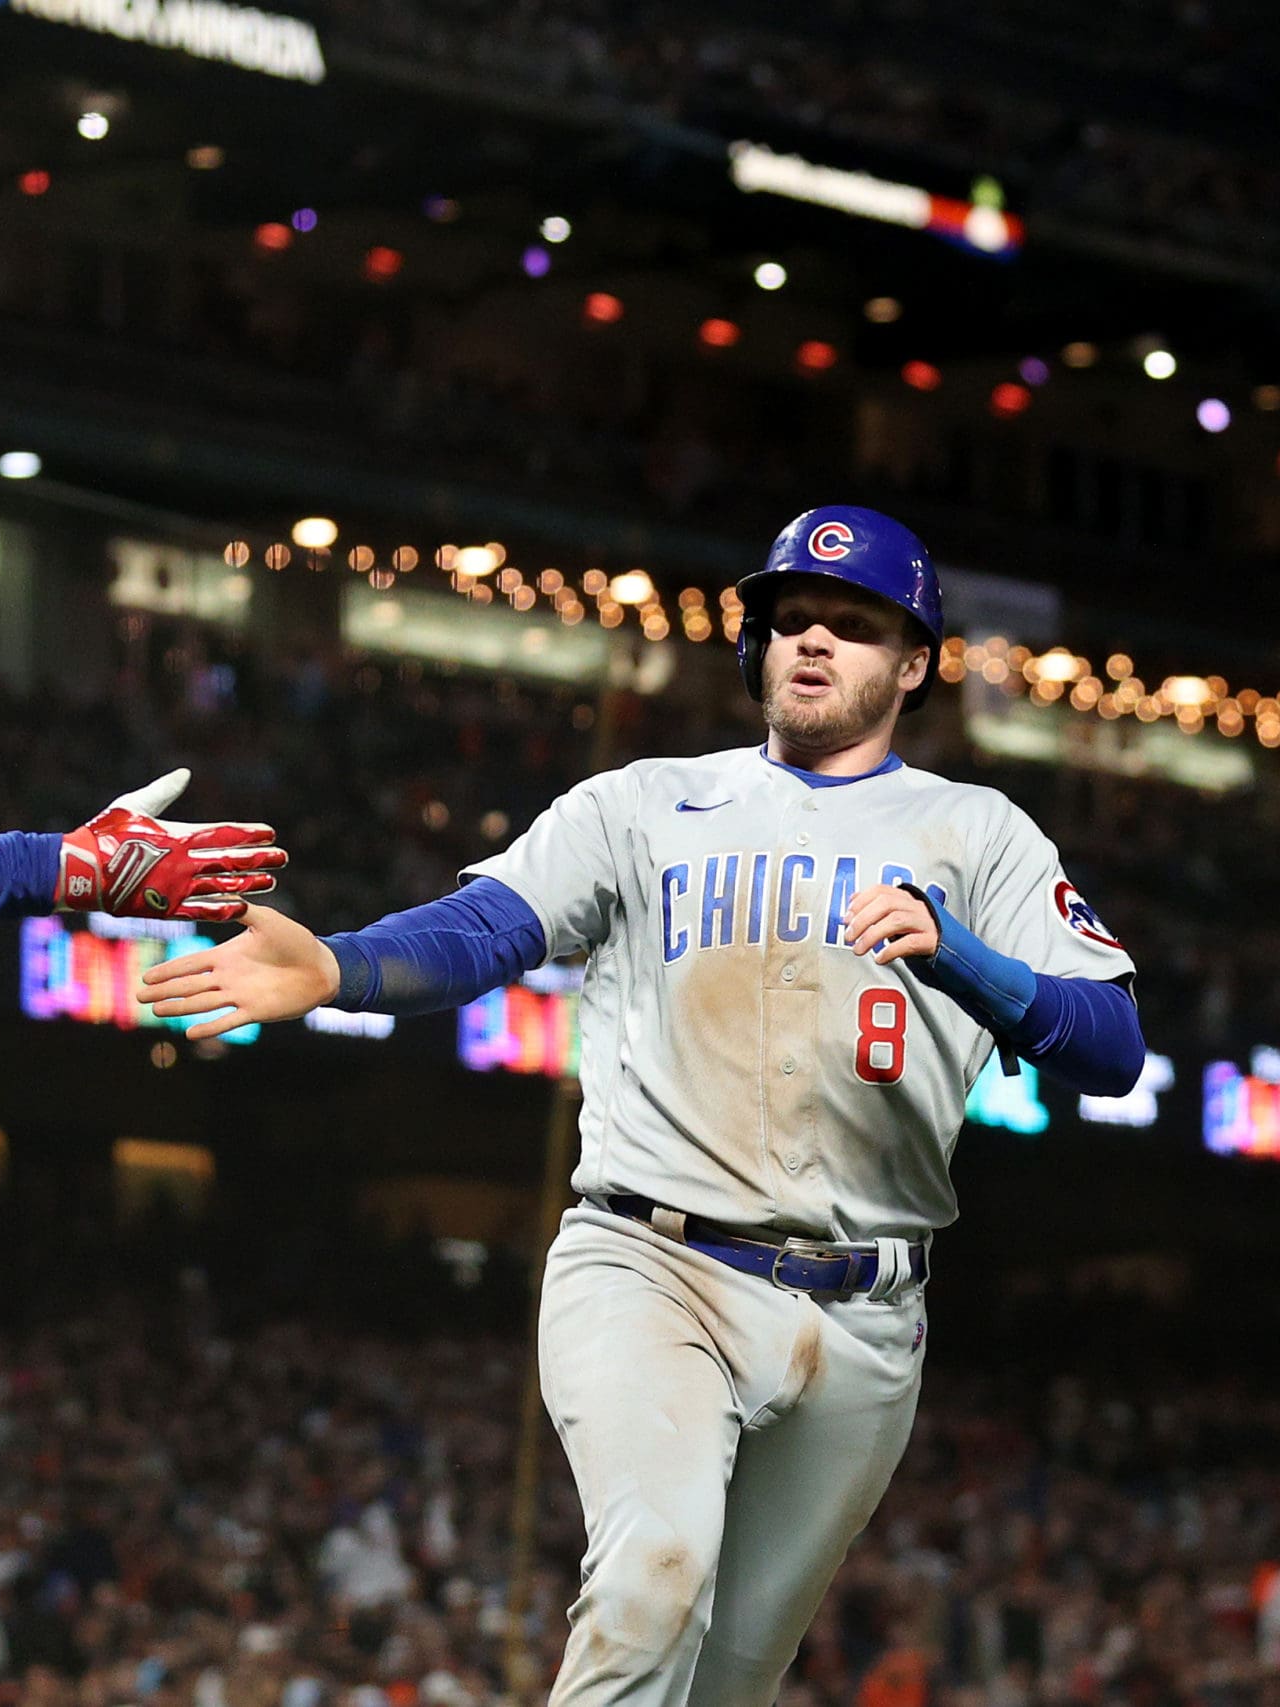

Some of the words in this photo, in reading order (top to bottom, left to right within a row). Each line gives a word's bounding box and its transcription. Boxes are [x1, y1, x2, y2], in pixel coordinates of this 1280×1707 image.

[807, 521, 855, 561] C
[661, 851, 948, 967] CHICA
[854, 984, 908, 1086] 8
